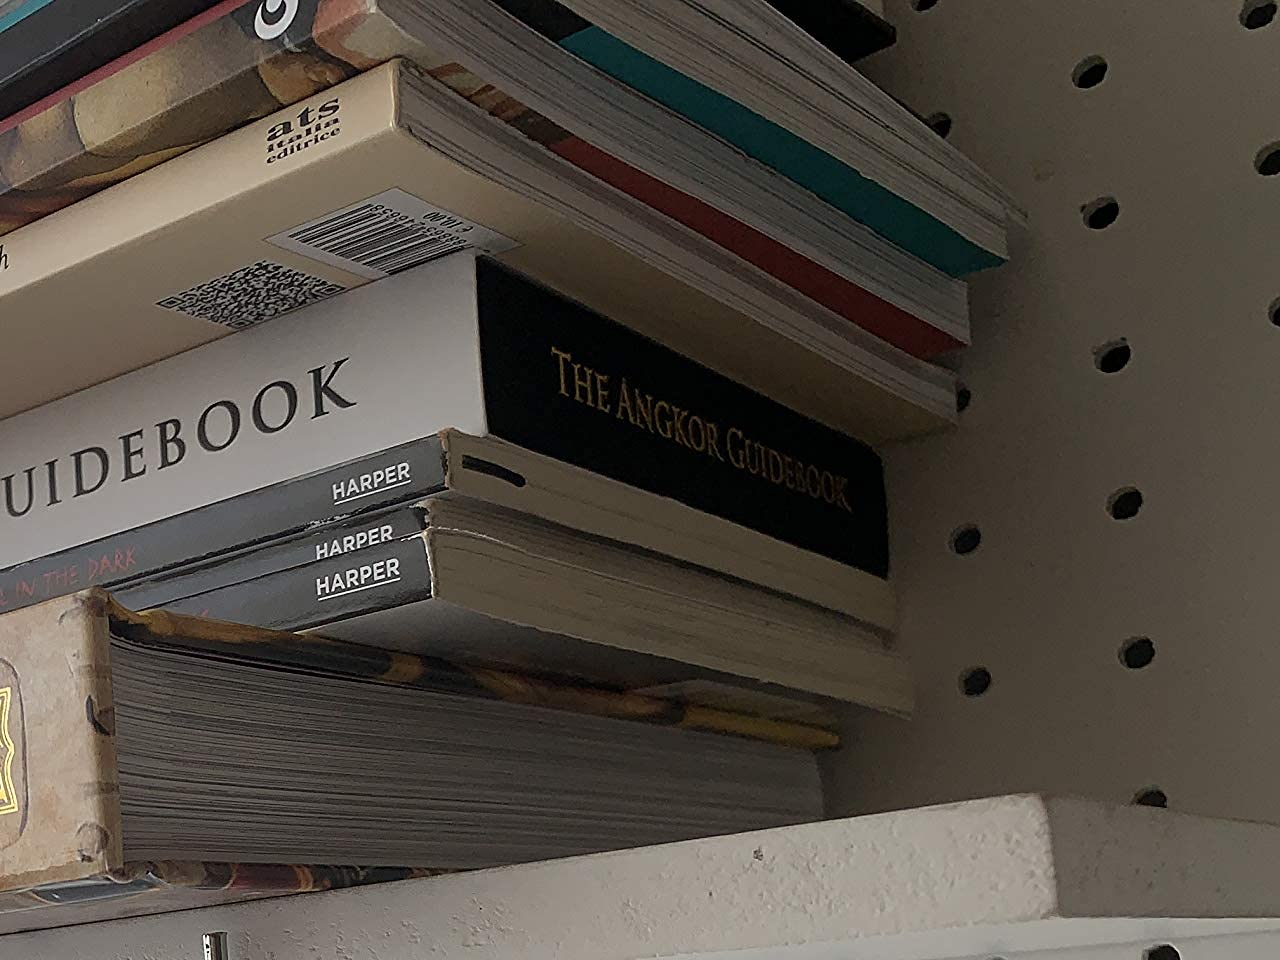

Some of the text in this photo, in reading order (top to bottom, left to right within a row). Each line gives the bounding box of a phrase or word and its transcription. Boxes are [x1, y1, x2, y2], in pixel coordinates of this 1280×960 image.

[267, 97, 340, 141] ats
[266, 131, 340, 164] editrice
[551, 346, 852, 513] THE ANGKOR GUIDEBOOK
[332, 461, 411, 502] HARPER
[315, 524, 394, 561] HARPER
[16, 580, 38, 597] IN
[43, 564, 79, 588] THE
[88, 546, 137, 581] DARK
[316, 557, 401, 598] HARPER
